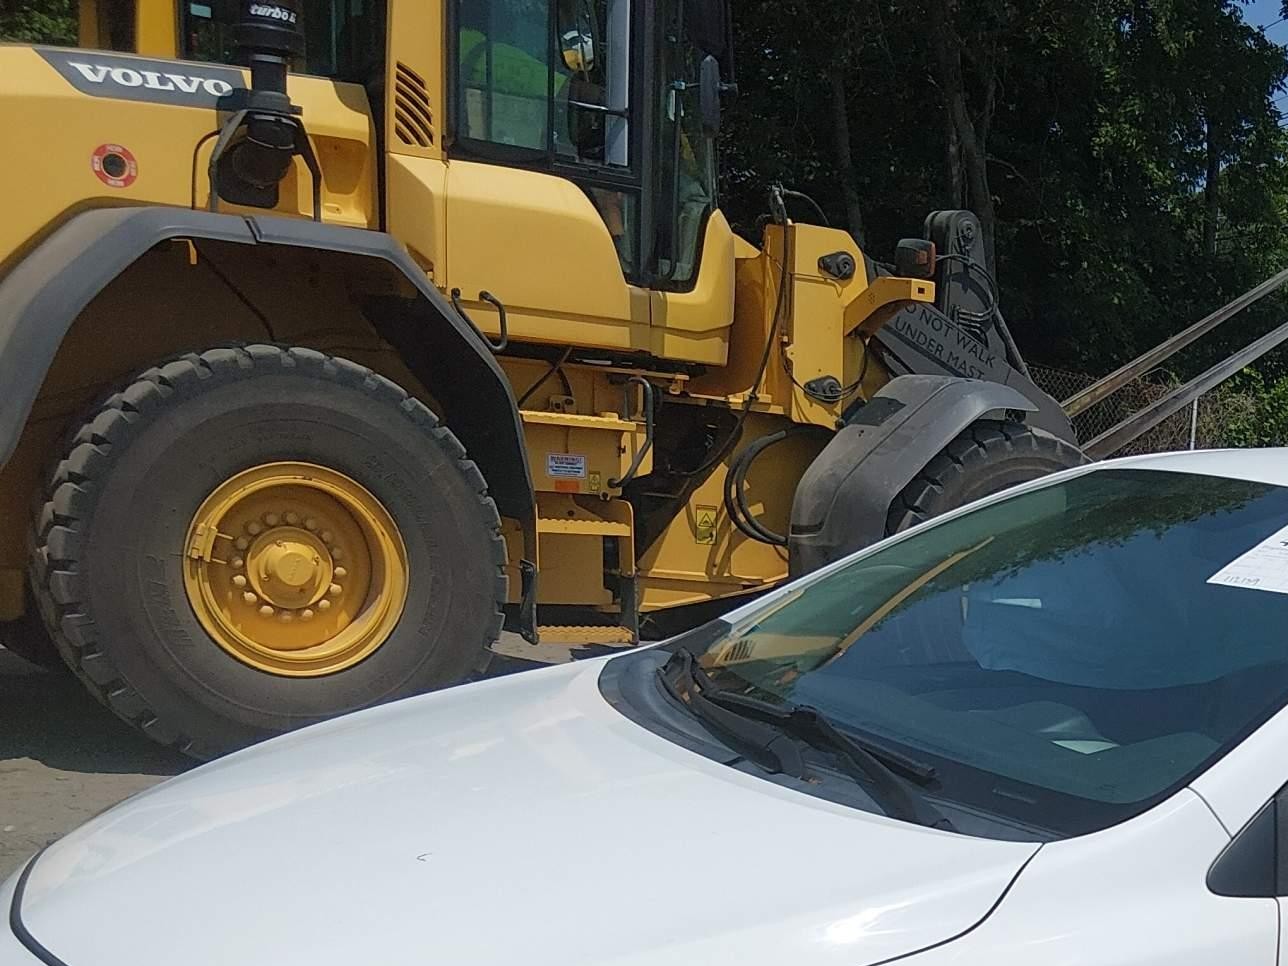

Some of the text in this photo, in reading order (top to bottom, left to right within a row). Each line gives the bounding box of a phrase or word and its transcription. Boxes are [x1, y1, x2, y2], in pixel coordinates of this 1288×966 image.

[250, 4, 288, 20] turbo
[68, 61, 233, 97] VOLVO
[895, 316, 985, 379] UNDER MAST
[919, 309, 954, 337] NOT
[957, 328, 996, 368] WALK
